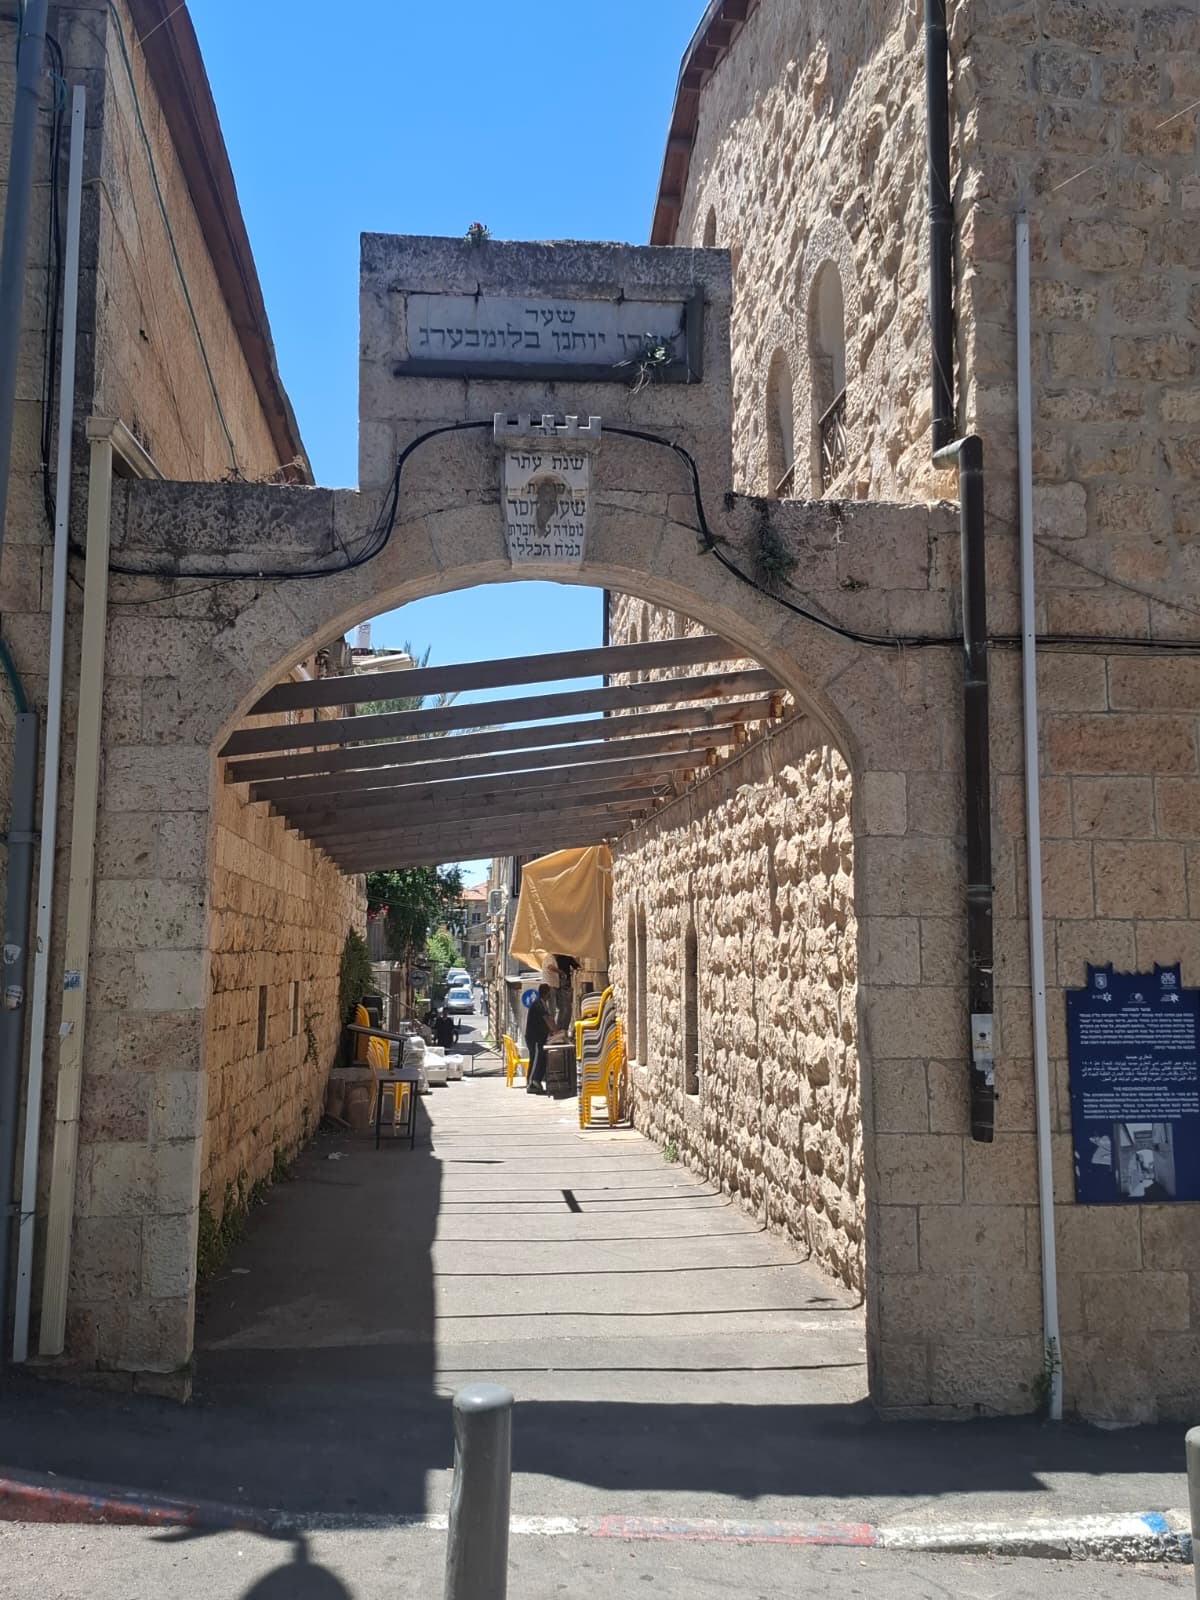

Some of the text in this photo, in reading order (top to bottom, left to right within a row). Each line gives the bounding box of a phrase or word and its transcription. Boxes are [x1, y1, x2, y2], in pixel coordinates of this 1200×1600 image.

[524, 308, 576, 327] שער
[419, 322, 541, 349] בלומבערג
[551, 330, 606, 353] יוחנן
[552, 454, 585, 470] שנת
